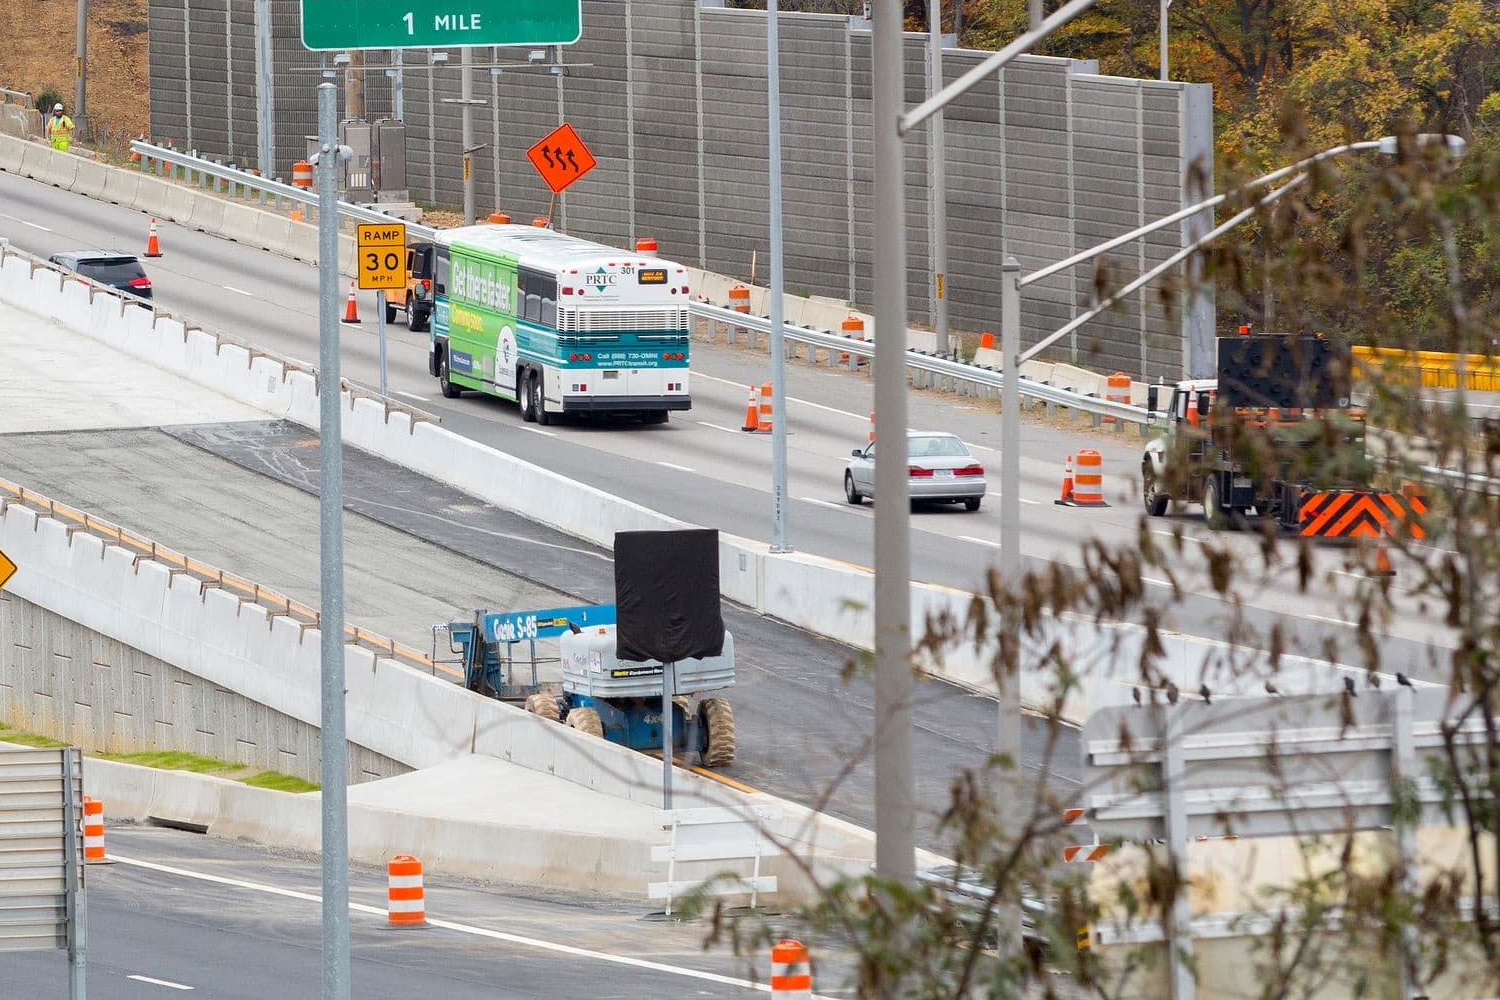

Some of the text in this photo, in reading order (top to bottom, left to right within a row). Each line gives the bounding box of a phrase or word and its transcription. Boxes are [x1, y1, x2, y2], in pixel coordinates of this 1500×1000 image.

[402, 12, 482, 36] 1 MILE
[364, 231, 400, 241] RAMP
[366, 253, 399, 271] 30
[620, 267, 635, 275] 301
[452, 261, 511, 312] Get there faster.
[586, 275, 617, 285] PRTC
[494, 618, 515, 640] Genie
[517, 615, 537, 638] S-85
